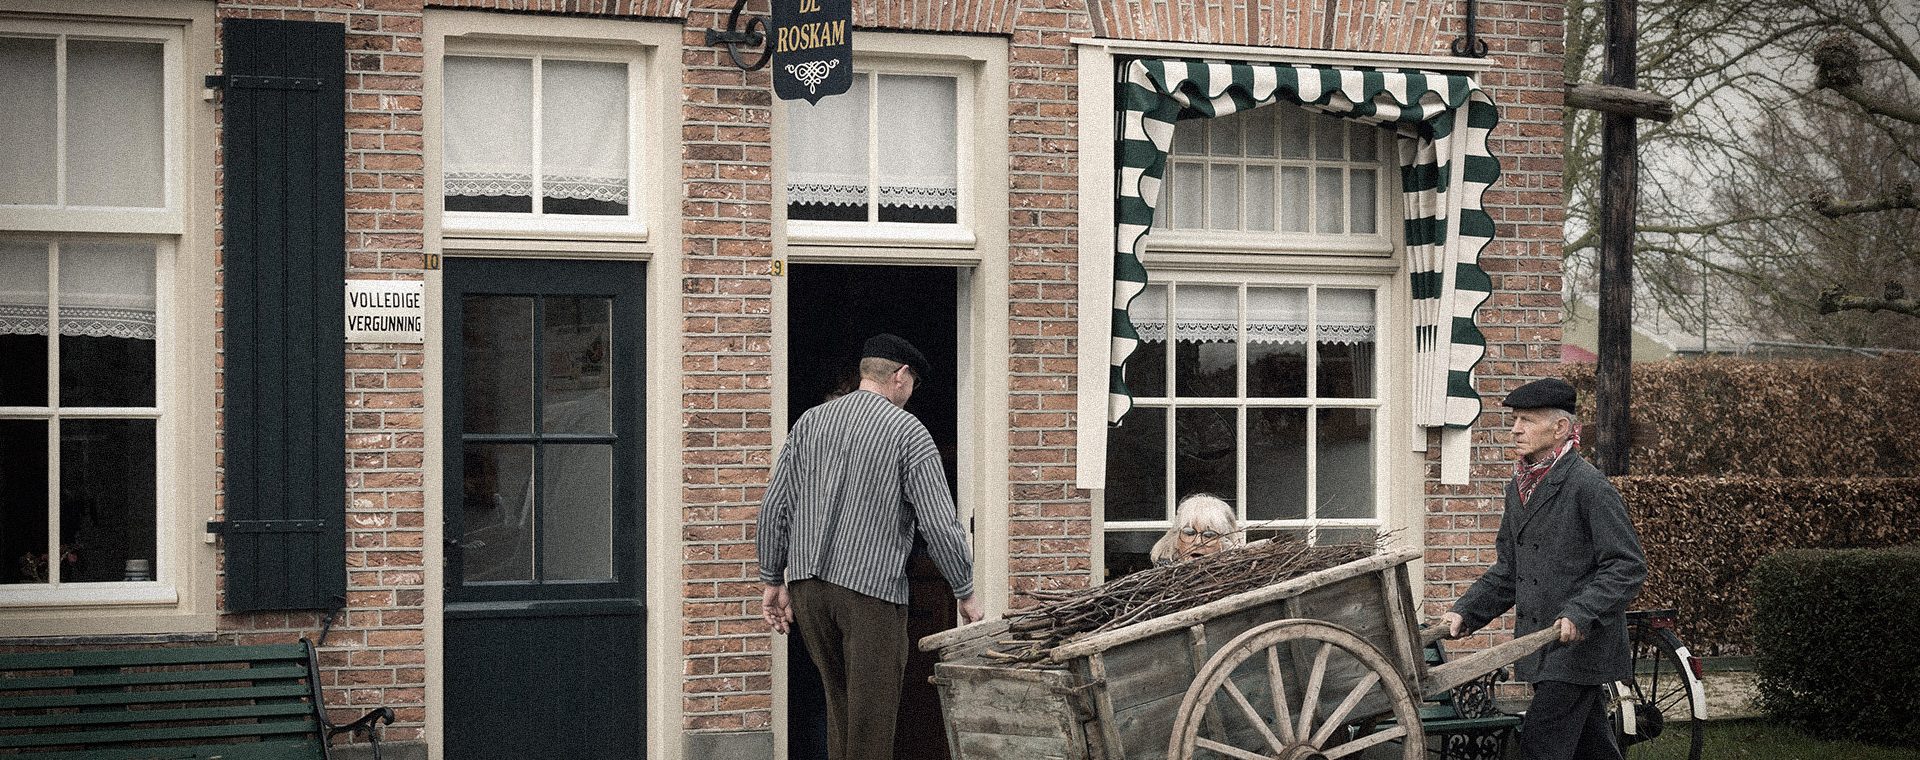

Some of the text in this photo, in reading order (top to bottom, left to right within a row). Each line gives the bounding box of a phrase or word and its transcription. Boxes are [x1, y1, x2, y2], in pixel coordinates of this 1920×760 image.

[776, 19, 846, 53] ROSKAM
[423, 253, 439, 270] 10
[774, 260, 781, 277] 9
[349, 292, 420, 308] VOLLEDIGE
[348, 315, 421, 332] VERGUNNING
